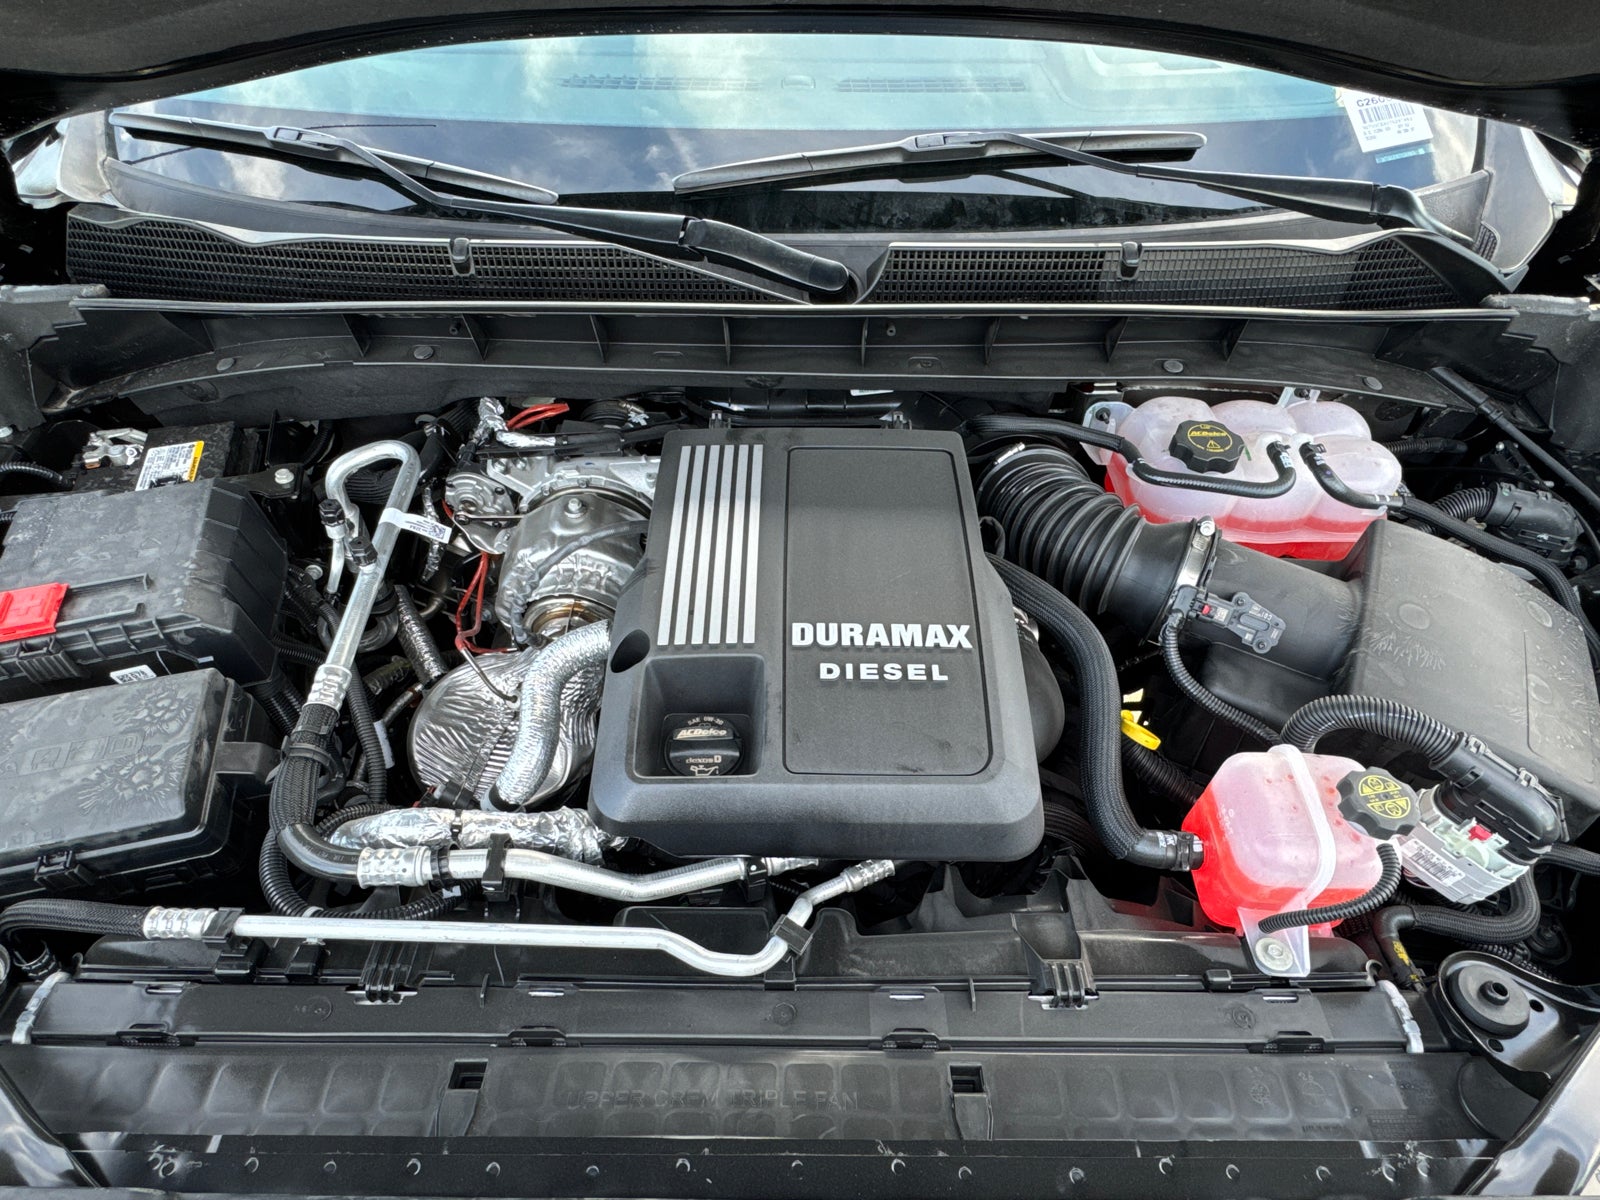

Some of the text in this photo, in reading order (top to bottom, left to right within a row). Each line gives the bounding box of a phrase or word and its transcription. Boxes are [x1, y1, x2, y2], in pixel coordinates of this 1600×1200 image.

[791, 622, 973, 649] DURAMAX
[819, 662, 949, 682] DIESEL
[676, 728, 727, 739] ACDelco
[814, 1090, 859, 1112] FAN
